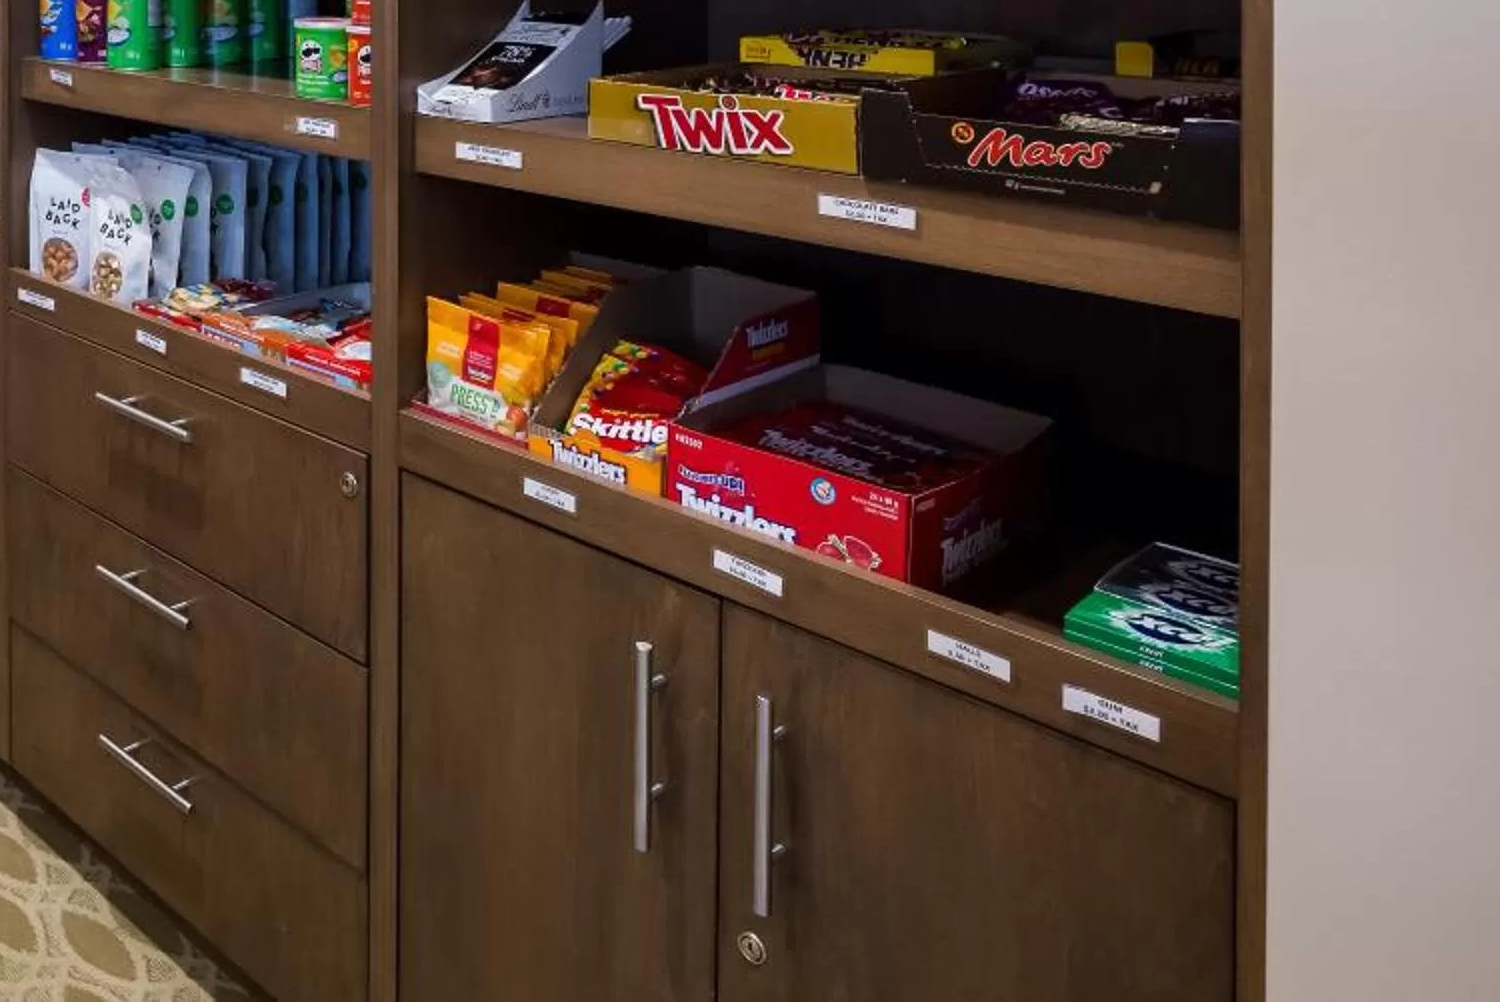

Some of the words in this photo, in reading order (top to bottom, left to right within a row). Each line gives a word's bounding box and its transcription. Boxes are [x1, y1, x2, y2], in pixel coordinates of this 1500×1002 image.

[638, 93, 794, 155] Twix
[967, 127, 1112, 168] Mars
[51, 198, 81, 214] LAID
[45, 211, 81, 230] BACK
[107, 208, 133, 229] LAID
[99, 223, 133, 247] BACK
[548, 438, 626, 484] Twizzlers
[1097, 699, 1123, 714] GUM
[1119, 717, 1139, 733] TAX
